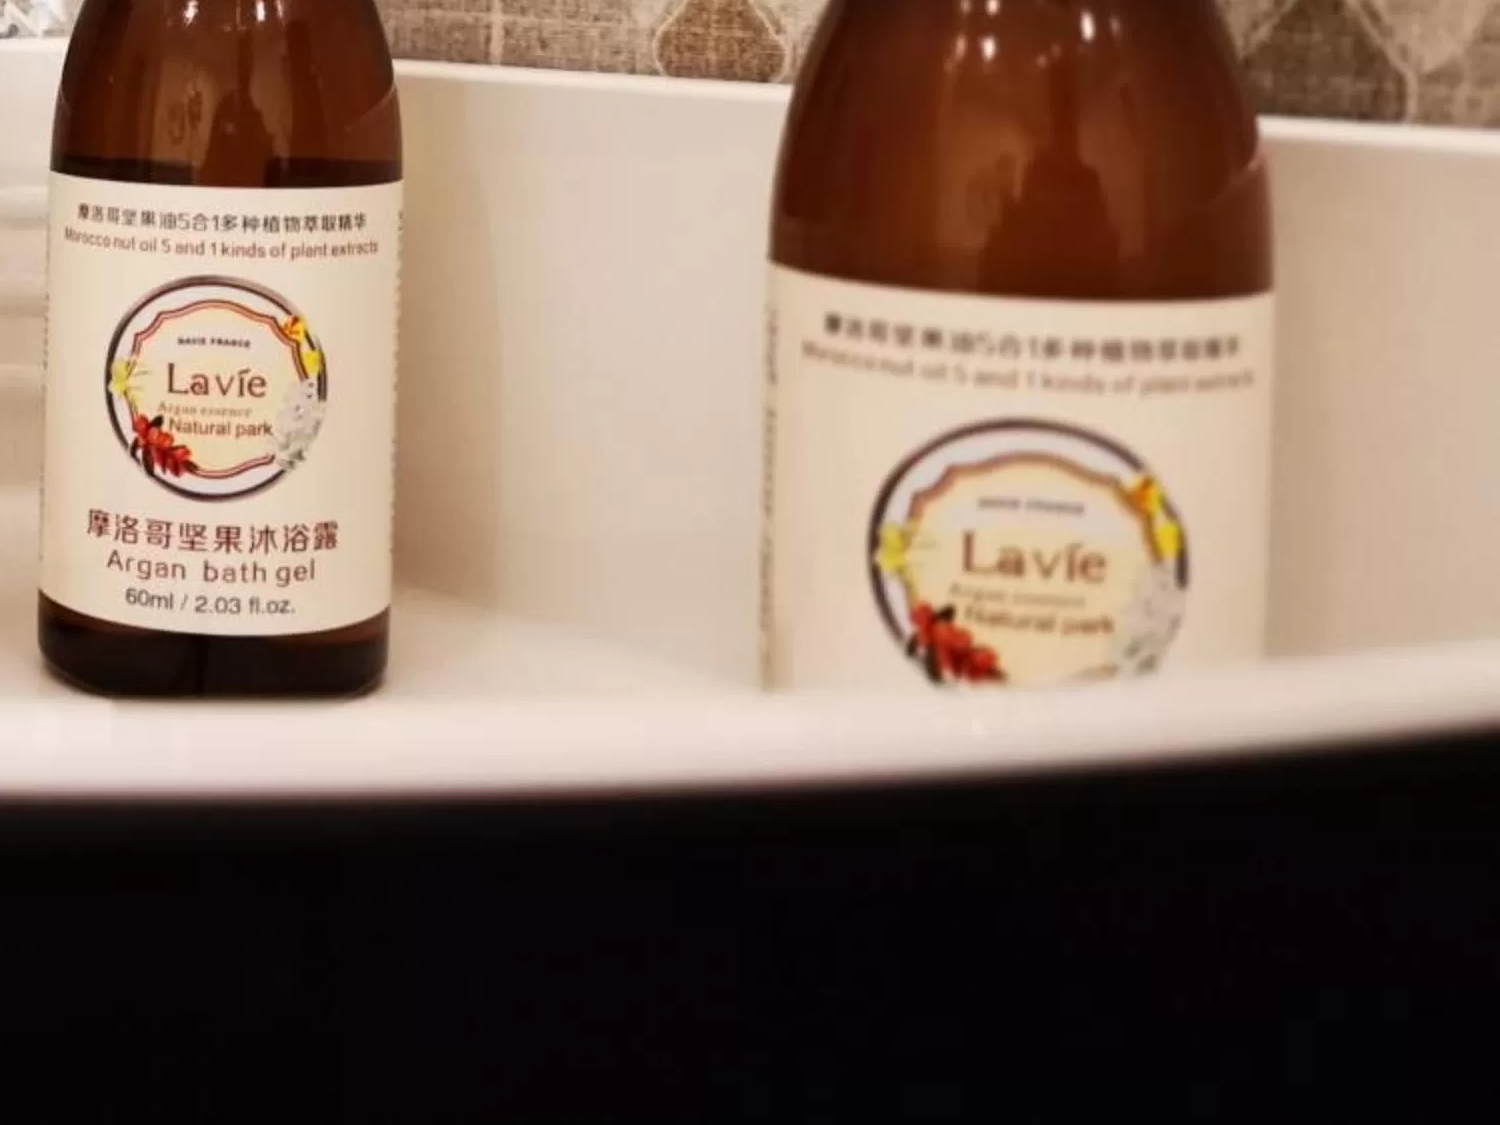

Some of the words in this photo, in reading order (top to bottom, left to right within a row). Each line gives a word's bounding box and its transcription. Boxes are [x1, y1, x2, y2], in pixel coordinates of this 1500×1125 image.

[113, 235, 136, 251] nut
[139, 236, 157, 252] oil
[161, 238, 171, 253] 5
[175, 240, 205, 257] and
[221, 242, 266, 259] kinds
[269, 242, 286, 259] of
[290, 242, 327, 261] plant
[331, 240, 379, 257] extracts
[168, 416, 232, 436] Natural
[235, 419, 274, 439] park
[87, 508, 340, 553] 摩洛哥坚果沐浴露
[106, 549, 187, 580] Argan
[202, 558, 267, 584] bath
[275, 559, 316, 587] gel
[125, 588, 174, 611] 60ml
[194, 595, 242, 615] 2.03
[249, 596, 296, 615] fl.oz.
